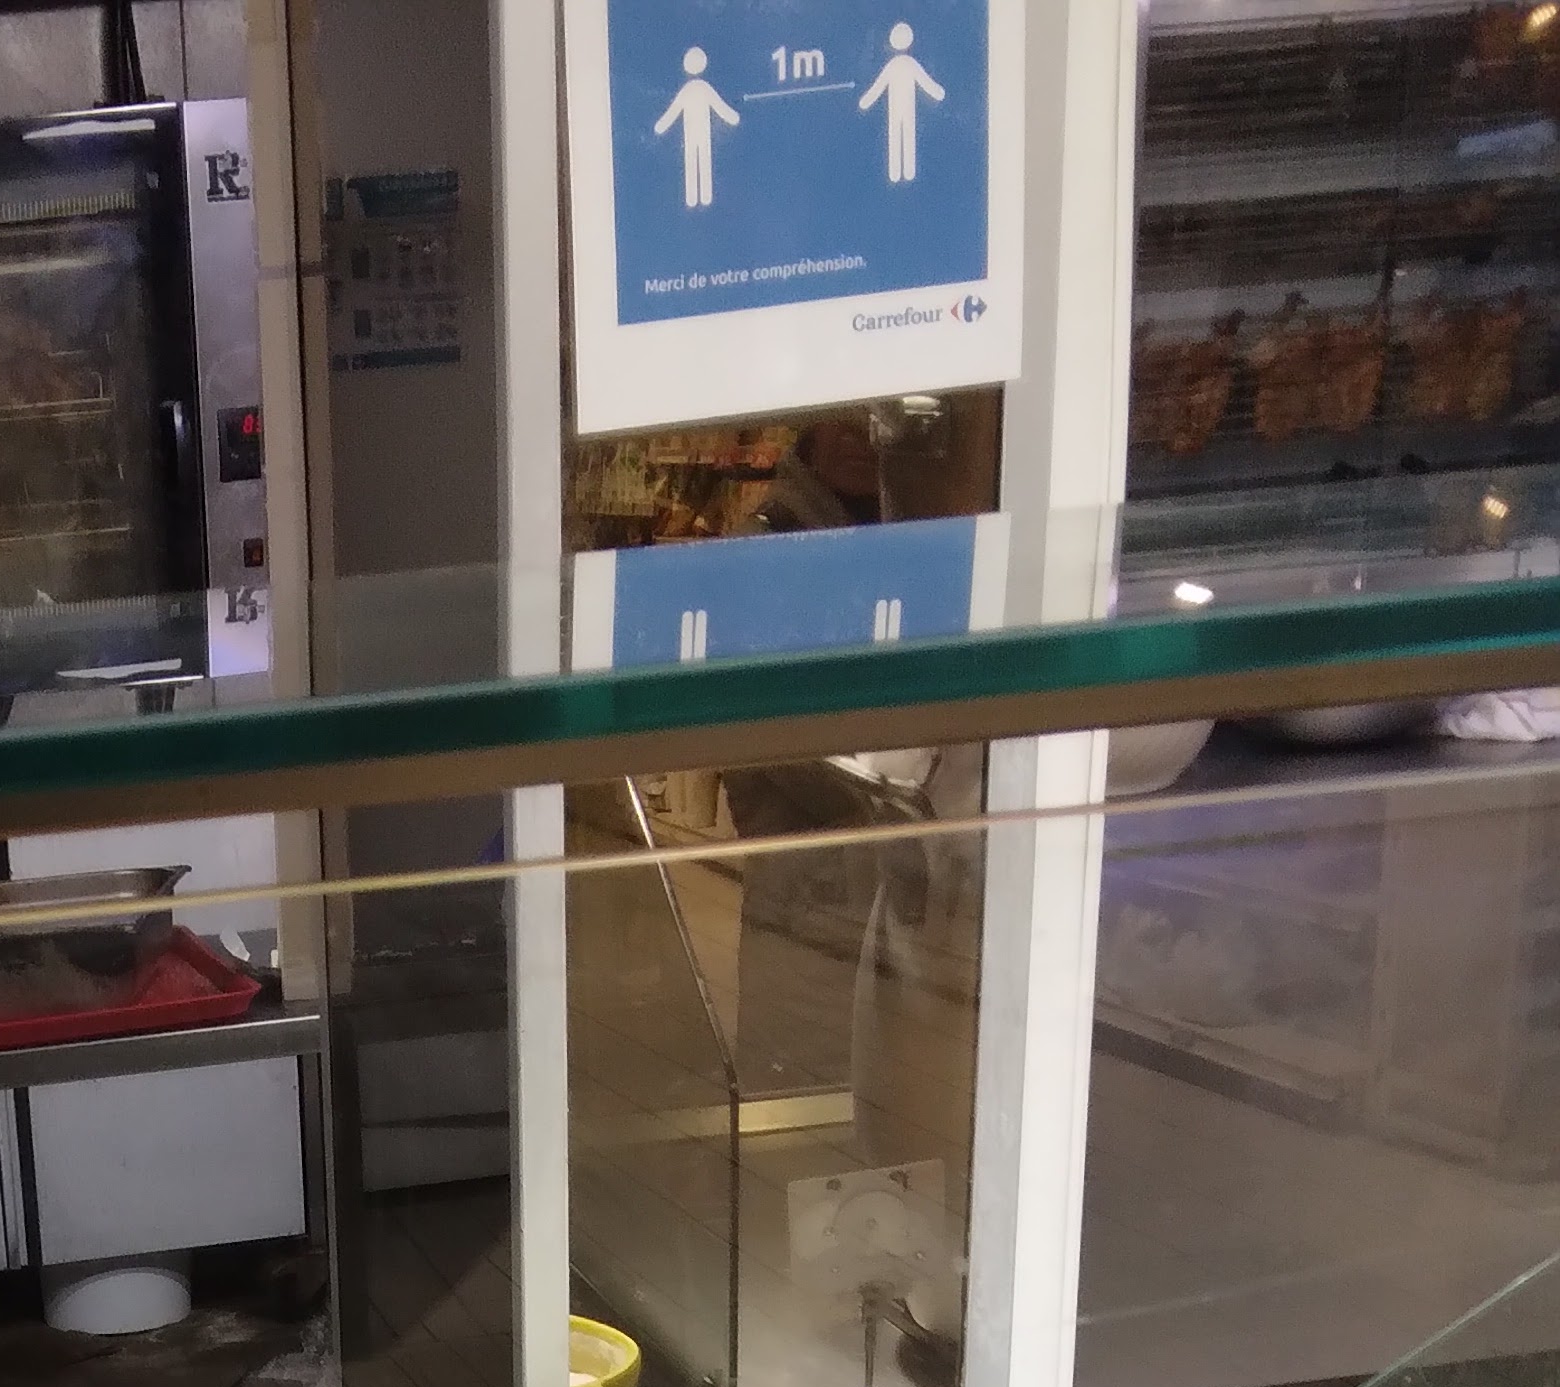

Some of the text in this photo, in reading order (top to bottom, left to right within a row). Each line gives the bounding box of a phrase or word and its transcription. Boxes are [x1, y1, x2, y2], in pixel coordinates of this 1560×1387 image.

[770, 46, 825, 81] 1m
[644, 254, 867, 294] Merci de votre compréhension.
[852, 306, 943, 332] Carrefour
